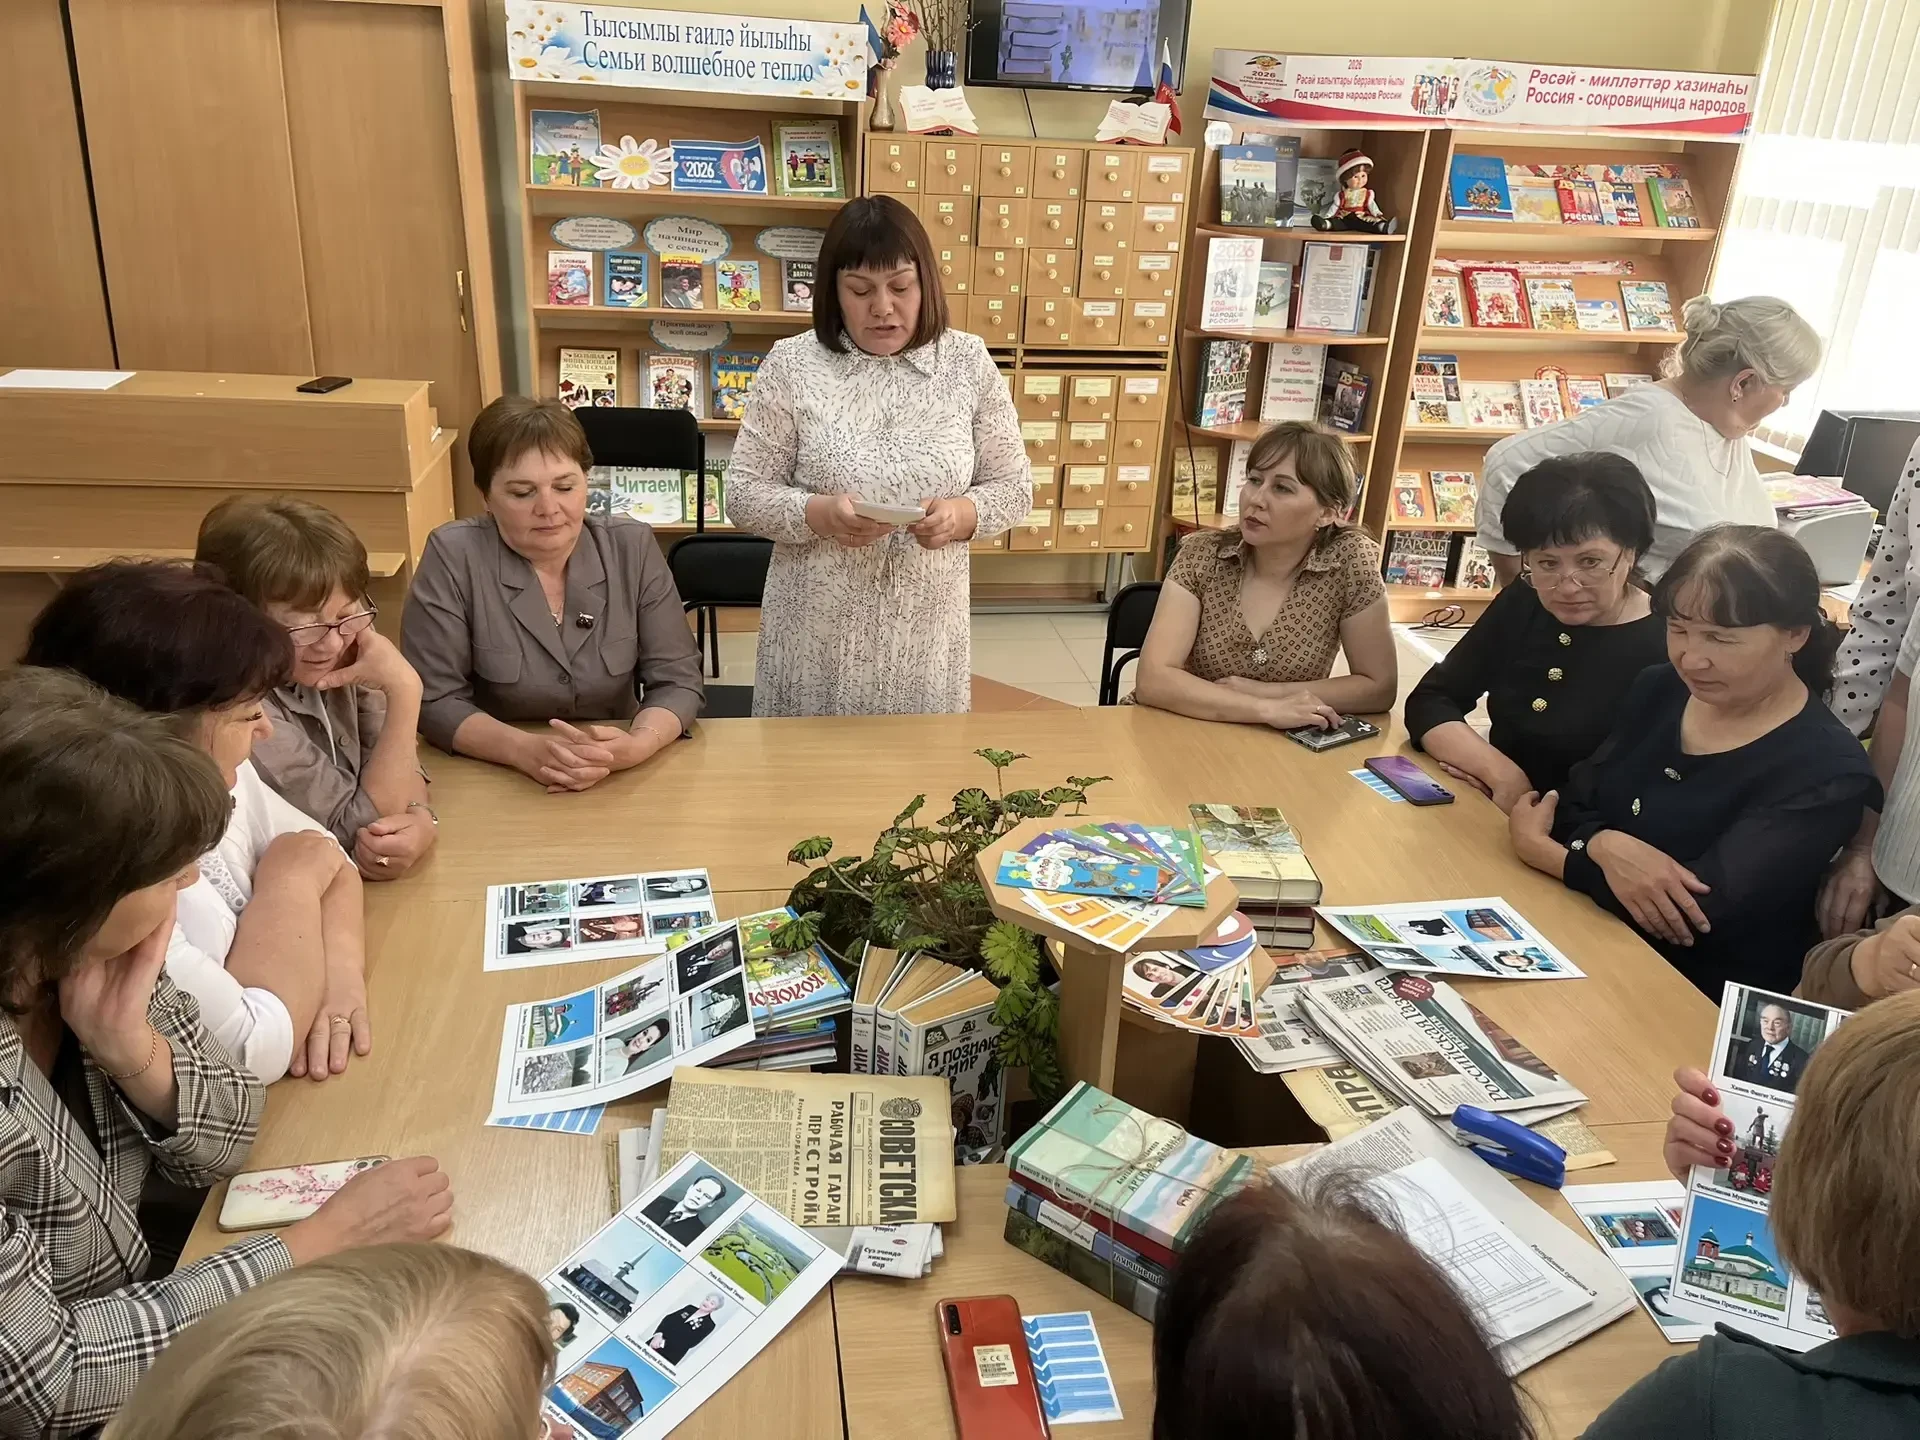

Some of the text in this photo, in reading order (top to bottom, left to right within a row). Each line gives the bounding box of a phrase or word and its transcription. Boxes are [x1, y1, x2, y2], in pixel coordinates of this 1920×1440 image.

[580, 10, 812, 53] Тылсымлы ғаилә йылыһы
[583, 40, 814, 83] Семьи волшебное тепло
[1348, 59, 1362, 70] 2026
[1251, 70, 1276, 78] 2026
[1528, 69, 1576, 86] Рәсәй
[1589, 75, 1671, 92] милләттәр
[1674, 79, 1748, 96] хазинаһы
[1293, 90, 1402, 101] Год единства народов России
[1526, 87, 1575, 105] Россия
[1586, 93, 1686, 111] сокровищница
[1689, 99, 1746, 115] народов
[686, 161, 715, 178] 2026
[678, 225, 703, 236] Мир
[658, 233, 720, 247] начинается
[676, 245, 708, 254] семьи
[1216, 243, 1255, 258] 2026
[718, 355, 760, 366] БОЛЬША
[1209, 373, 1248, 387] НАРОДЫ
[615, 476, 680, 493] Читаем
[1394, 538, 1449, 551] НАРОДЫ
[928, 1035, 1000, 1070] Я ПОЗНАЮ
[1413, 1014, 1511, 1103] Российская
[897, 1055, 908, 1077] ИР
[947, 1055, 979, 1077] МИР
[1323, 1064, 1386, 1115] ПРА
[803, 1115, 823, 1225] ПЕРЕСТРОЙК
[826, 1100, 844, 1226] РАБОЧАЯ ГАРАН
[879, 1119, 917, 1225] СОВЕТСКА
[872, 1261, 885, 1269] бар
[1589, 1289, 1597, 1298] 3
[1684, 1288, 1698, 1298] Храм
